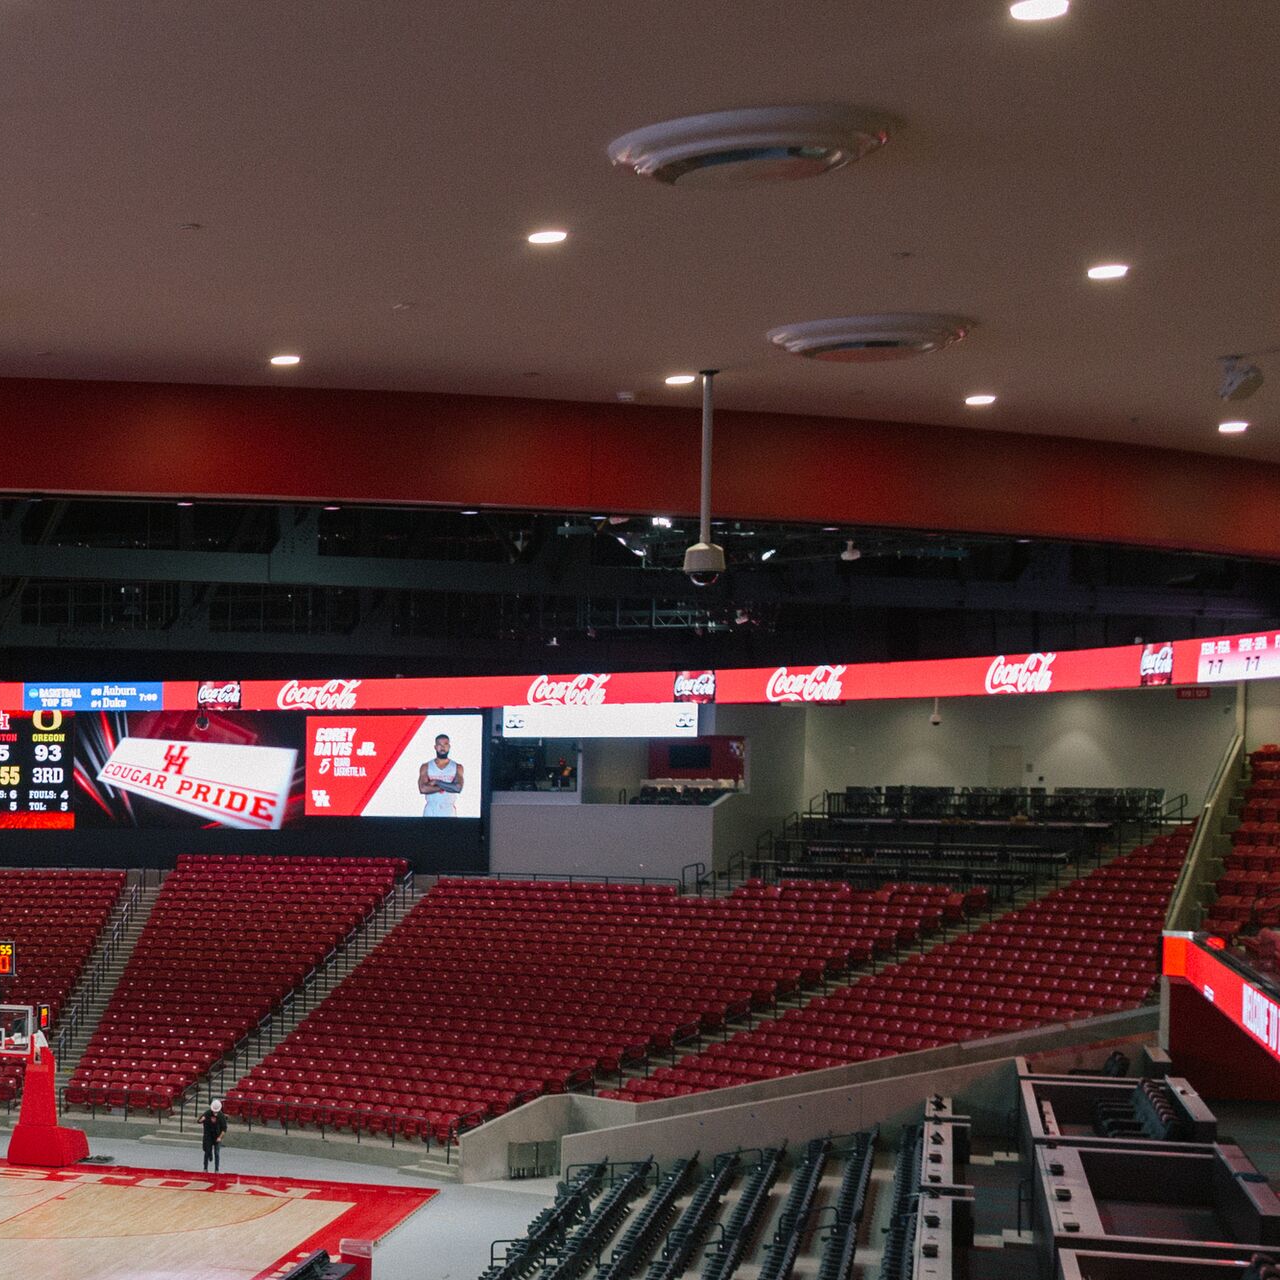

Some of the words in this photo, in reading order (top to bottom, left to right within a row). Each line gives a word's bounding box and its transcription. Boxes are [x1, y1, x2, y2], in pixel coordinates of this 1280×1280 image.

[985, 652, 1057, 694] Coca-Cola
[527, 674, 611, 706] Coca-Cola
[766, 665, 847, 701] Coca-Cola
[277, 680, 362, 710] Coca-Cola
[32, 733, 65, 742] OREGON
[34, 744, 62, 762] 93
[313, 741, 353, 756] DAVIS
[319, 758, 331, 774] 5
[32, 767, 64, 784] 3RD
[9, 790, 18, 799] 6
[29, 790, 56, 799] FOULS:
[60, 790, 69, 799] 4
[104, 763, 167, 790] COUGAR
[176, 779, 277, 822] PRIDE
[9, 802, 18, 811] 5
[29, 802, 47, 811] TOL:
[60, 802, 68, 811] 5
